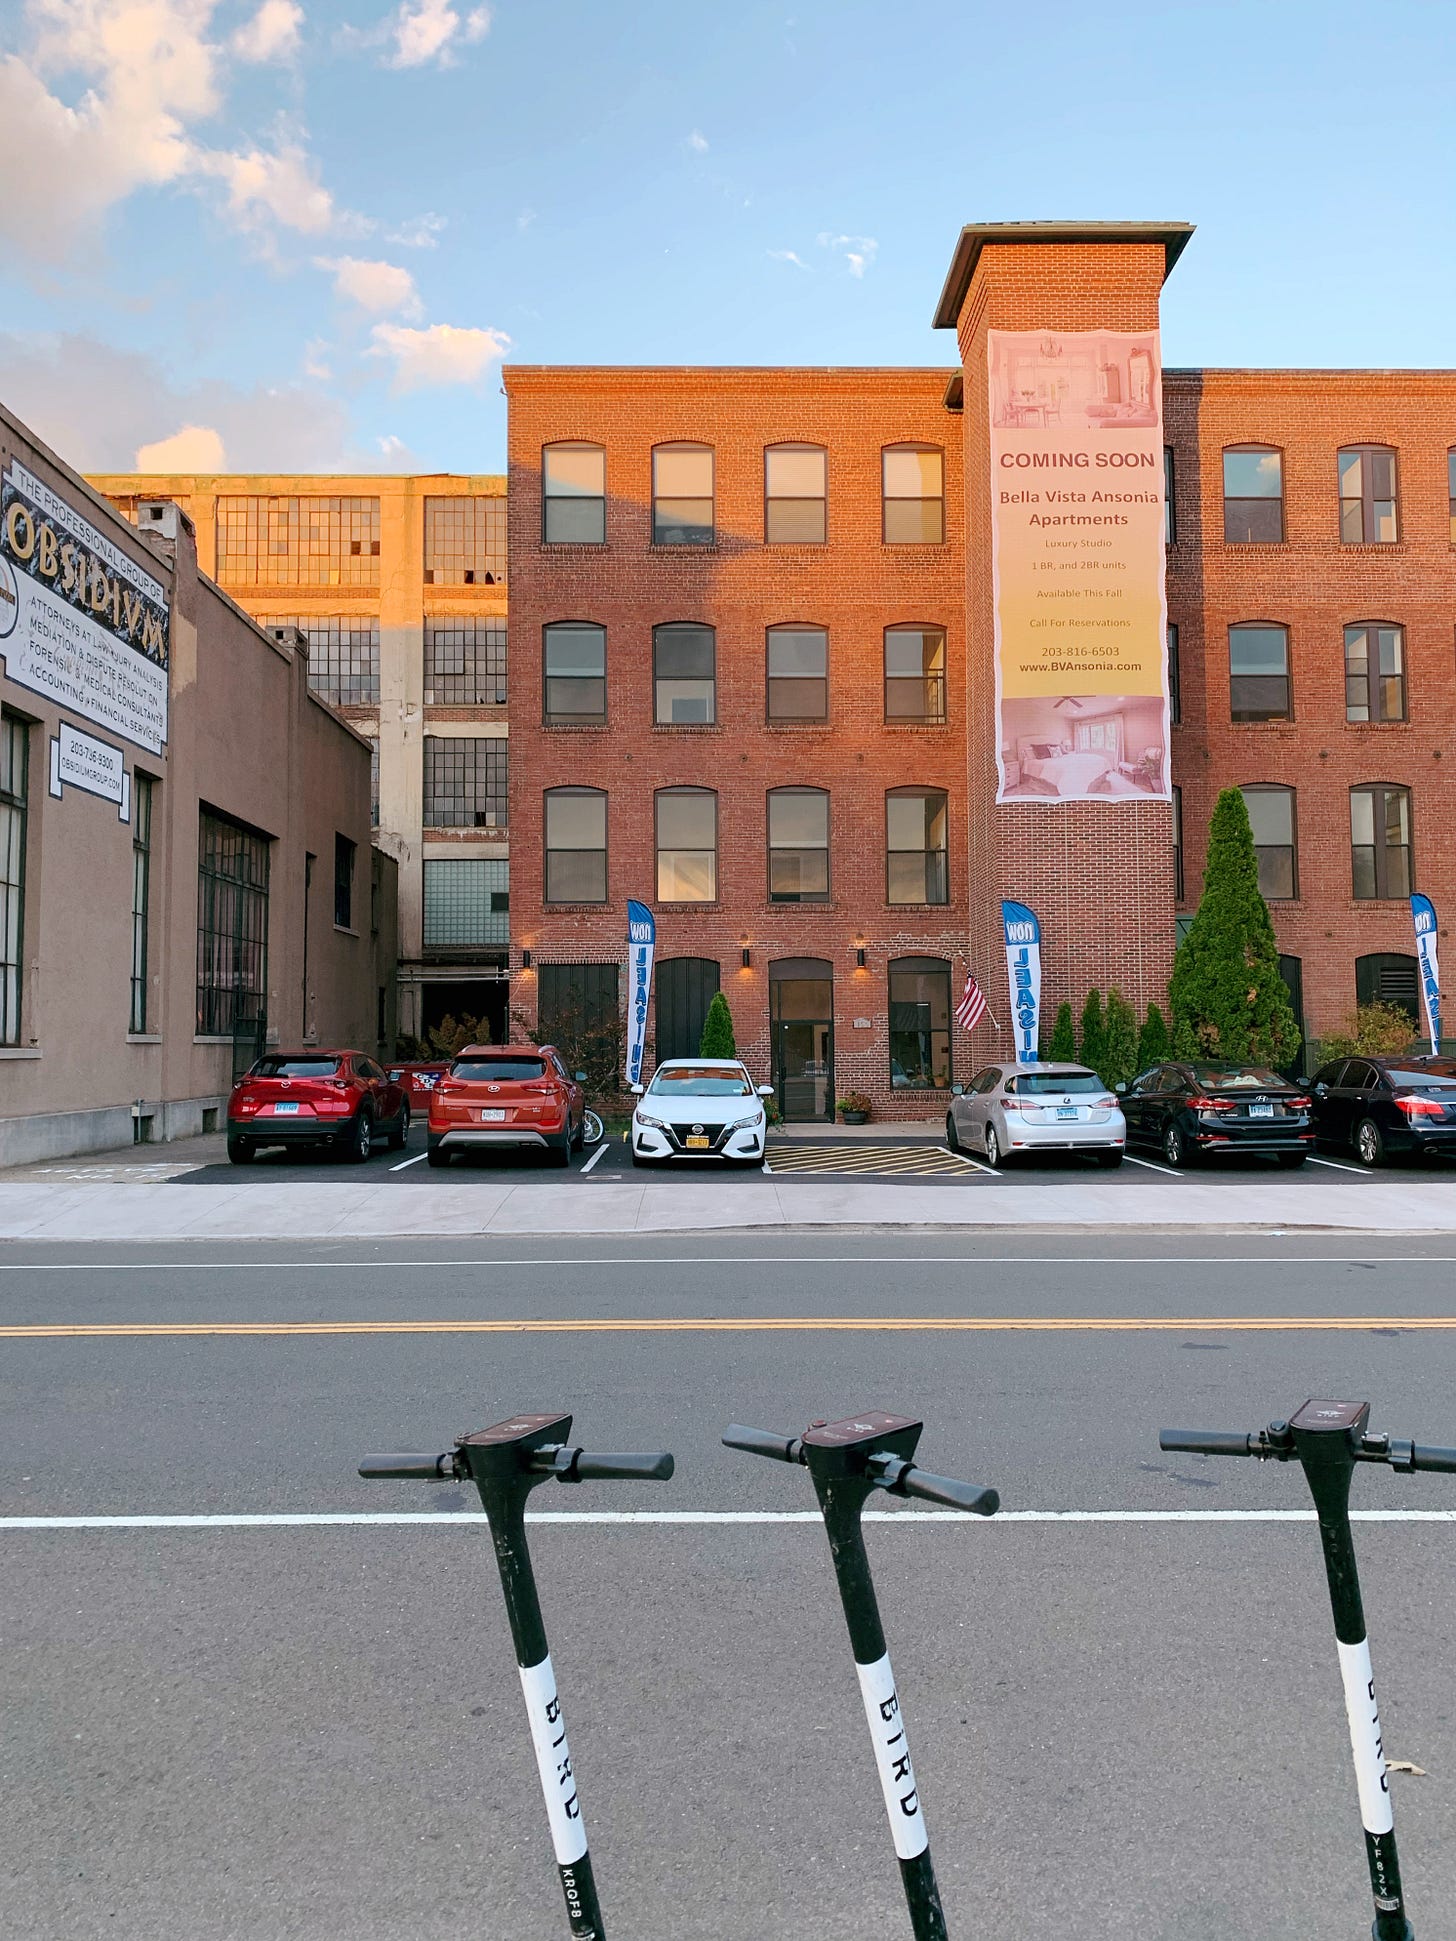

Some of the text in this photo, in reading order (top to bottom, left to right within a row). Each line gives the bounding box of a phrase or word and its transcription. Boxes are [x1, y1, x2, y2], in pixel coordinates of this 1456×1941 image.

[1000, 452, 1155, 468] COMING SOON
[1000, 490, 1158, 503] Bella Vista Ansonia
[1029, 514, 1128, 528] Apartments
[18, 470, 161, 598] THE PROFESSIONAL GROUP OF
[1045, 539, 1112, 549] Luxury Studio
[1032, 561, 1127, 571] 1 BR, and 2BR units
[1037, 589, 1122, 598] Available This Fall
[1030, 618, 1131, 628] Call For Reservations
[31, 596, 80, 636] ATTORNEYS
[82, 629, 92, 644] AT
[133, 664, 163, 690] ANALYSIS
[1041, 647, 1120, 657] 203-816-6503
[30, 616, 158, 707] MEDIATION & DISPUTE RESOLUTON
[1020, 661, 1142, 672] www.BVAnsonia.com
[29, 664, 84, 703] ACCOUNTING
[91, 698, 129, 728] FINANCIAL
[84, 674, 116, 701] MEDICAL
[546, 1696, 580, 1820] BIRD
[880, 1692, 919, 1818] BIRD
[1372, 1836, 1388, 1896] YF82X
[562, 1868, 582, 1918] KRQF8
